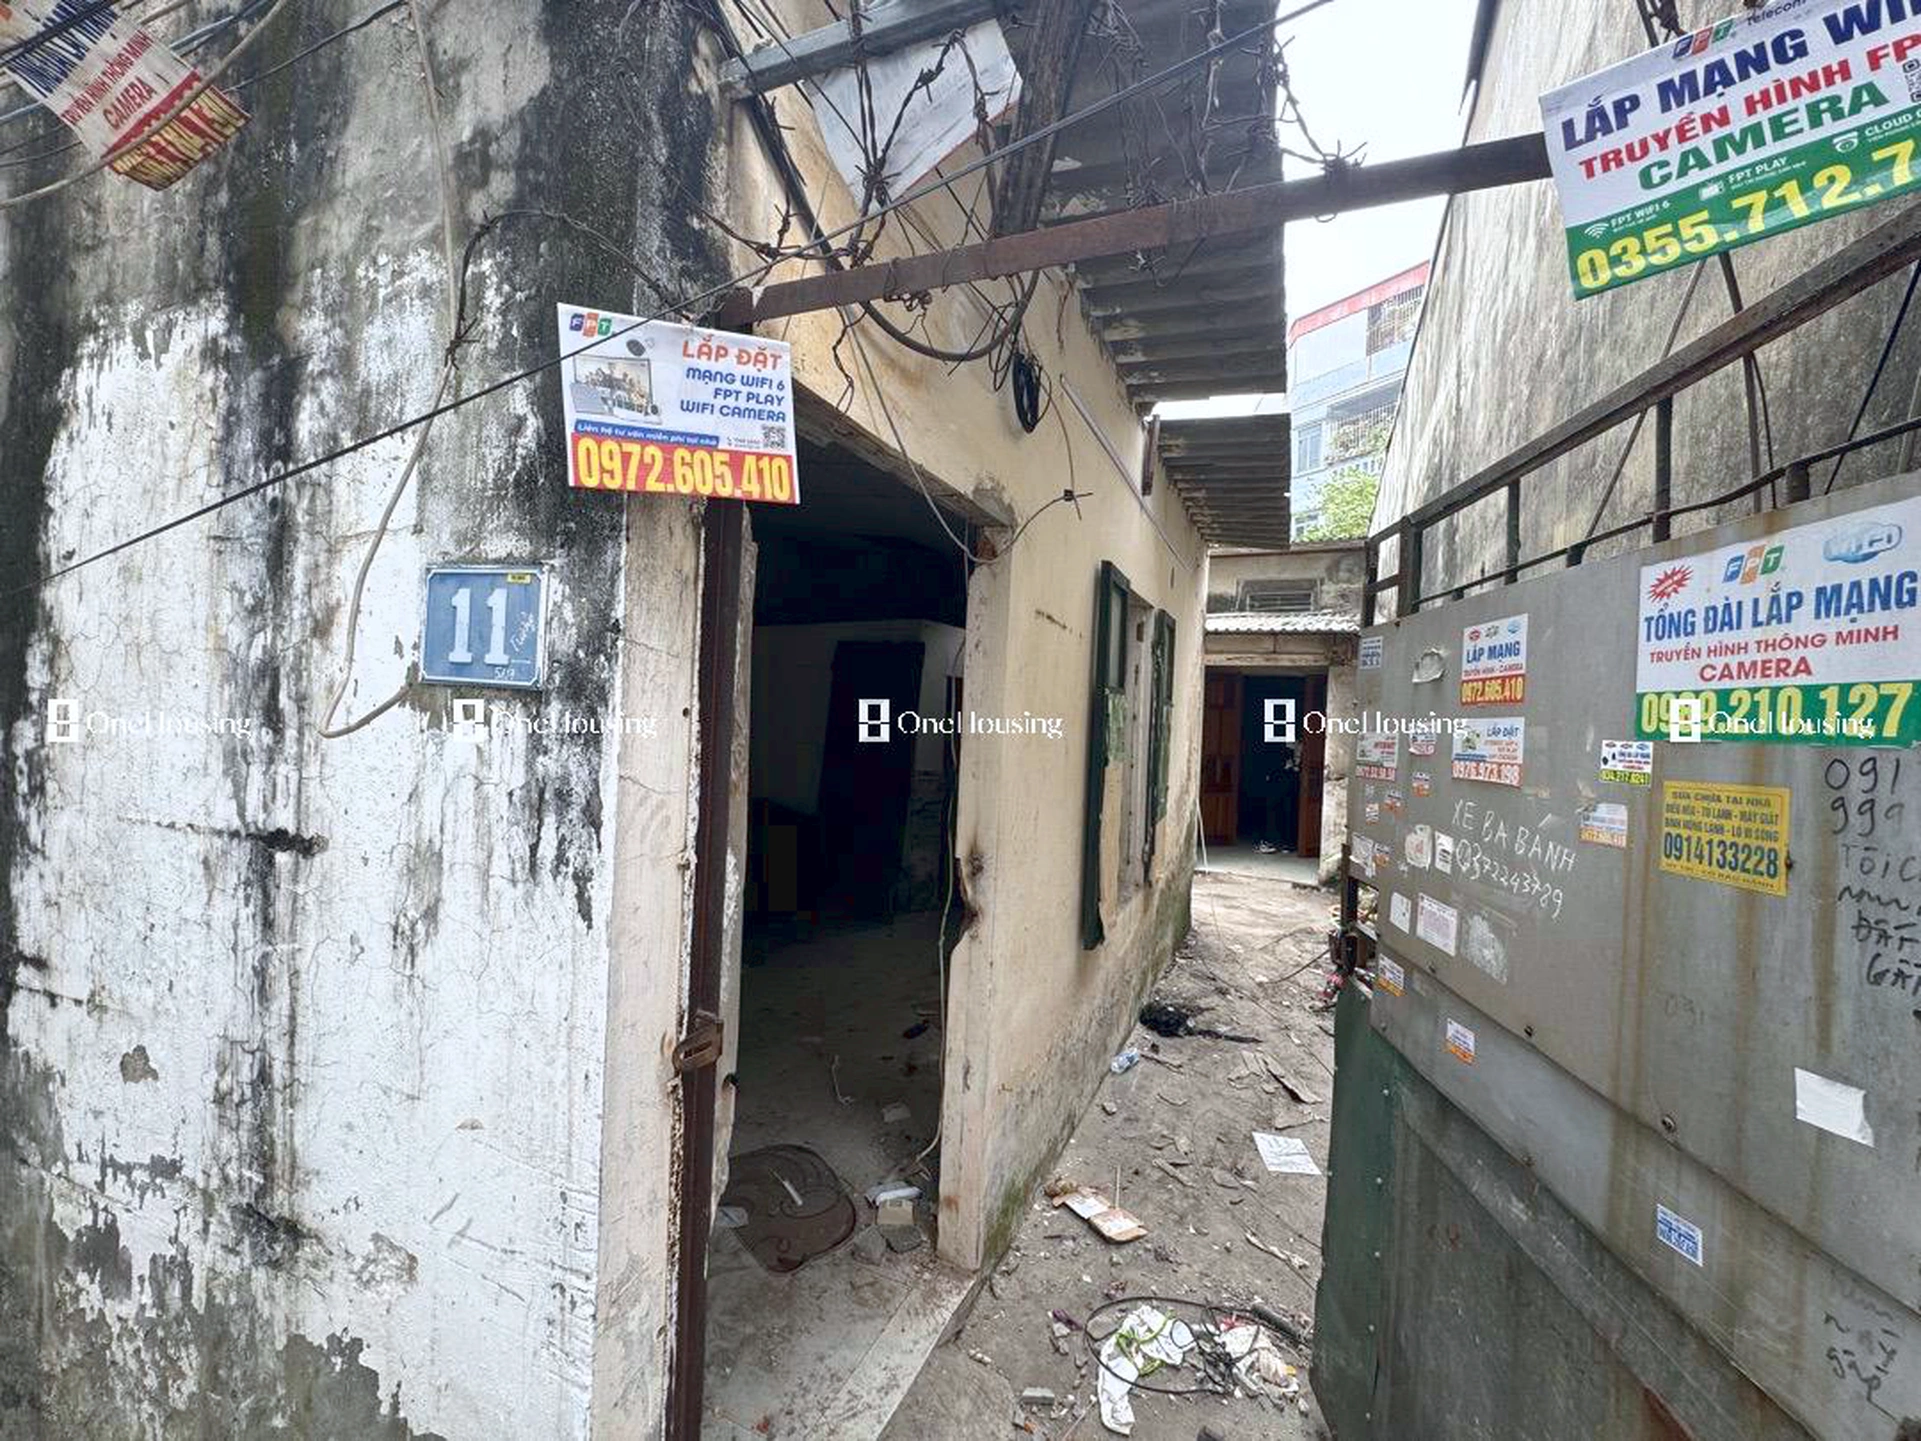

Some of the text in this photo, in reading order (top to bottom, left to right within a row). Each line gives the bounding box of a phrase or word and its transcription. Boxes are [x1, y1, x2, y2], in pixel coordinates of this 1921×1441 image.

[1561, 0, 1921, 151] LẮP MẠNG WI
[103, 76, 158, 130] CAMERA
[1579, 105, 1731, 180] TRUYỀN
[1744, 59, 1852, 116] HÌNH
[1637, 81, 1890, 190] CAMERA
[1755, 156, 1788, 175] PLAY
[569, 312, 612, 338] FPT
[682, 334, 782, 373] LẮP ĐẶT
[686, 367, 785, 391] MẠNG WIFI 6
[713, 387, 785, 407] FPT PLAY
[680, 400, 786, 423] WIFI CAMERA
[577, 437, 791, 500] 0972.605.410
[1722, 544, 1785, 585] FPT
[448, 587, 510, 666] 11
[1644, 570, 1918, 643] TỔNG ĐÀI LẮP MẠNG
[1649, 625, 1899, 664] TRUYỀN HÌNH THÔNG MINH
[1699, 656, 1813, 683] CAMERA
[1452, 799, 1478, 830] XE
[1664, 832, 1778, 879] 0914133228
